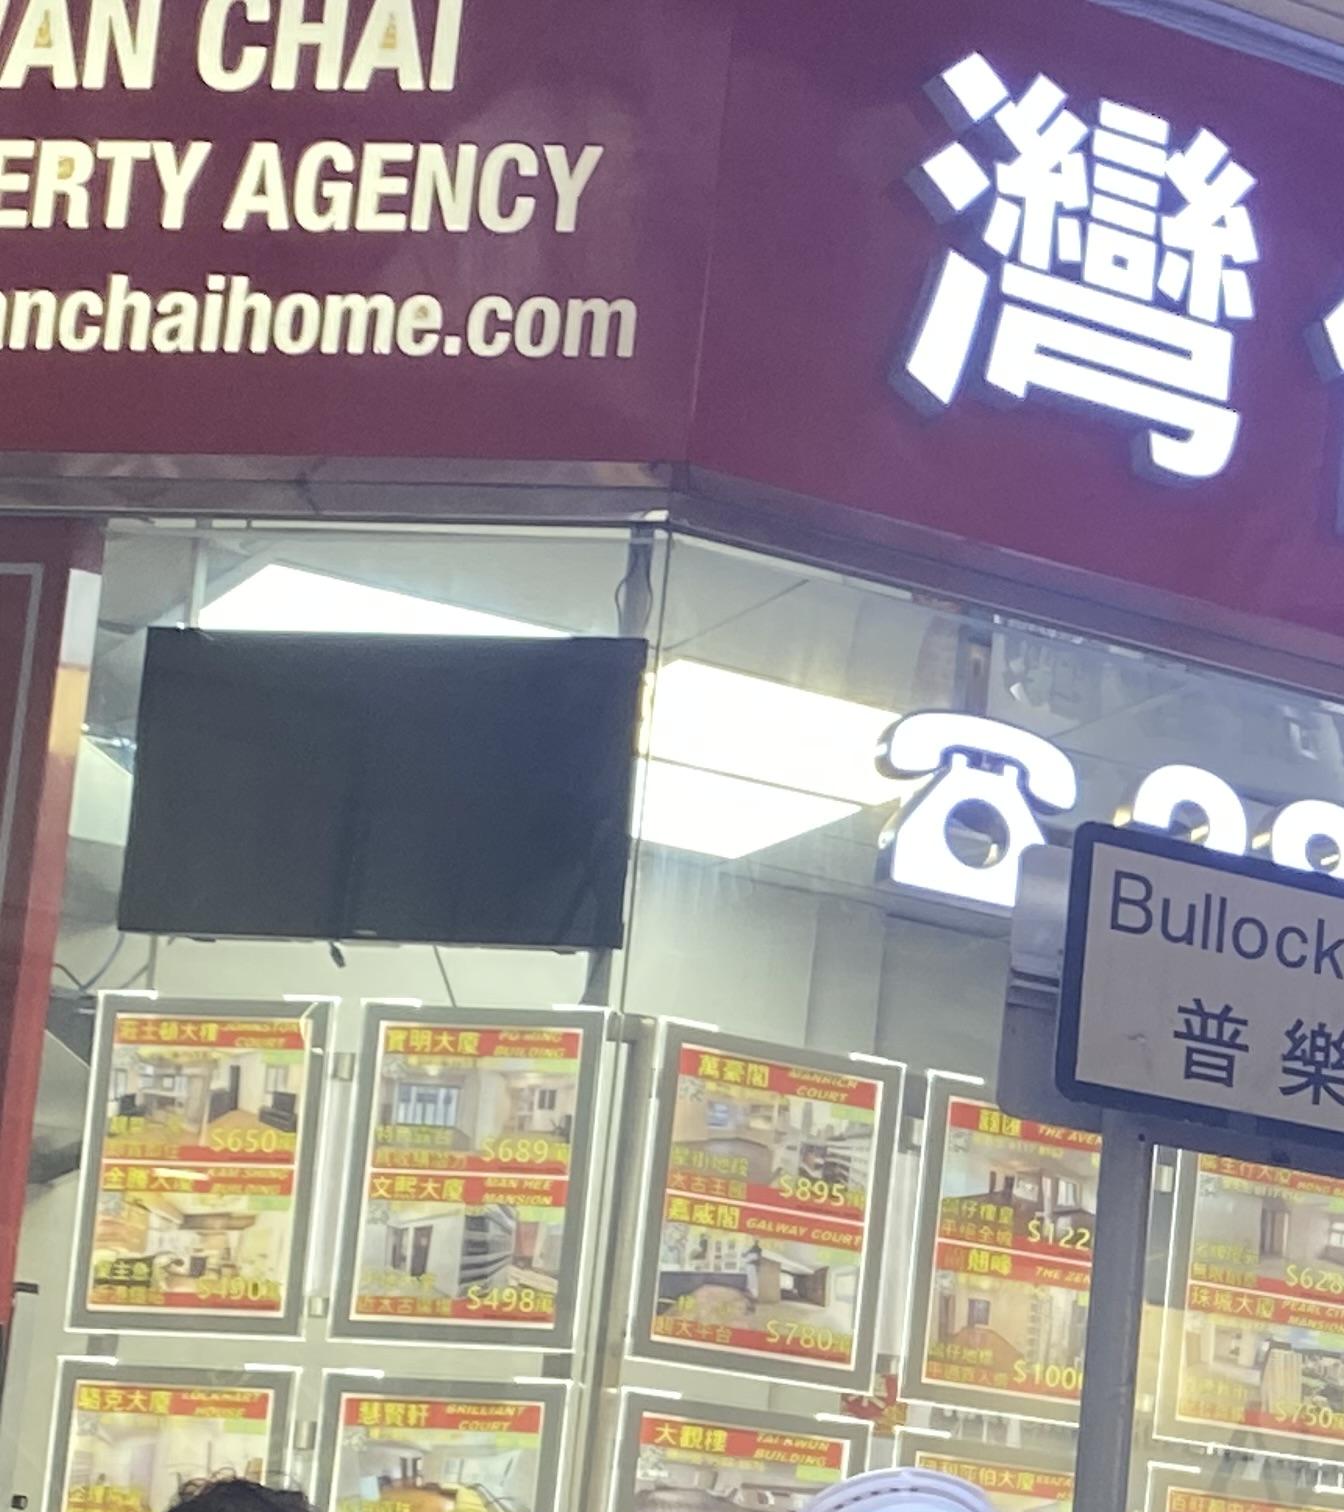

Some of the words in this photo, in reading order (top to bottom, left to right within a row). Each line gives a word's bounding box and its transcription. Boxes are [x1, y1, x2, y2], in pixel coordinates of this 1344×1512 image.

[0, 0, 156, 91] AN
[197, 0, 465, 91] CHAI
[223, 142, 605, 234] AGENCY
